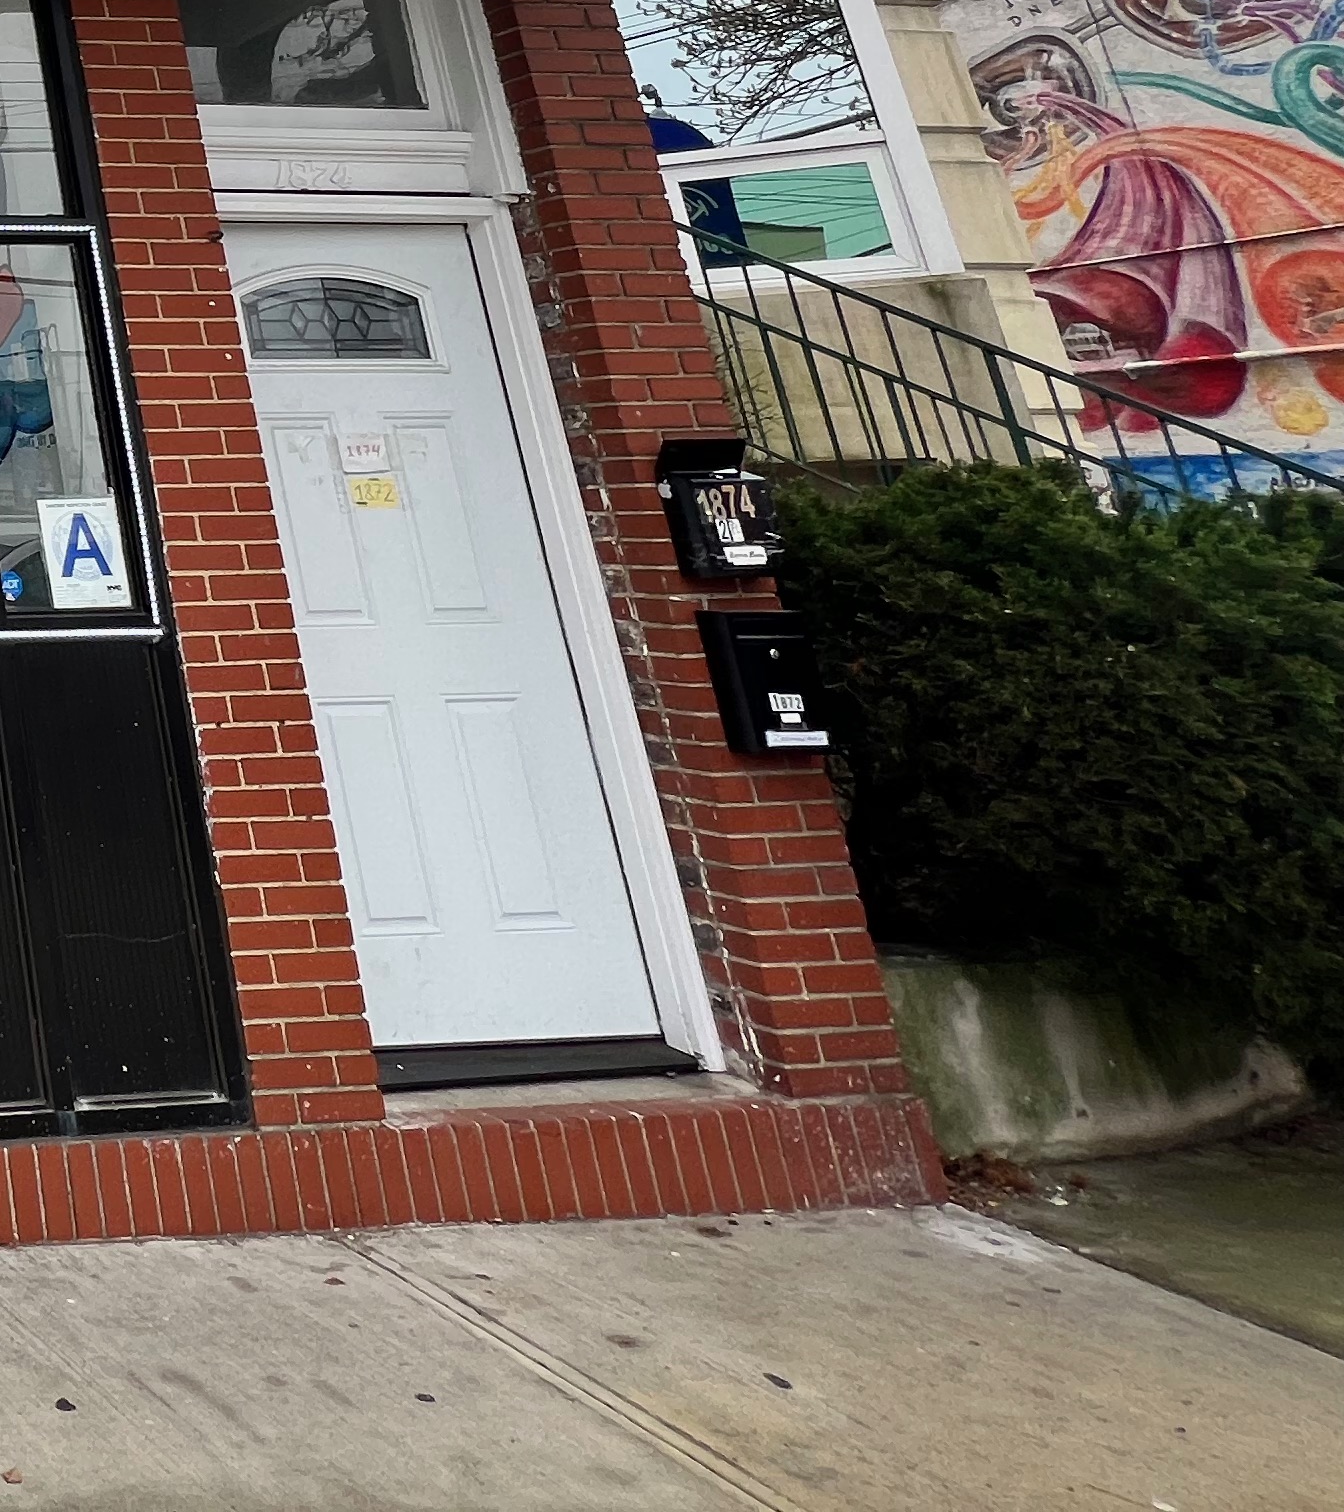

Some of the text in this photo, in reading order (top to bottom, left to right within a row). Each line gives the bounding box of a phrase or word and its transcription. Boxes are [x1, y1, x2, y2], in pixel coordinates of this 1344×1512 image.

[696, 484, 756, 522] 1874
[61, 512, 113, 577] A
[772, 694, 803, 709] 1872
